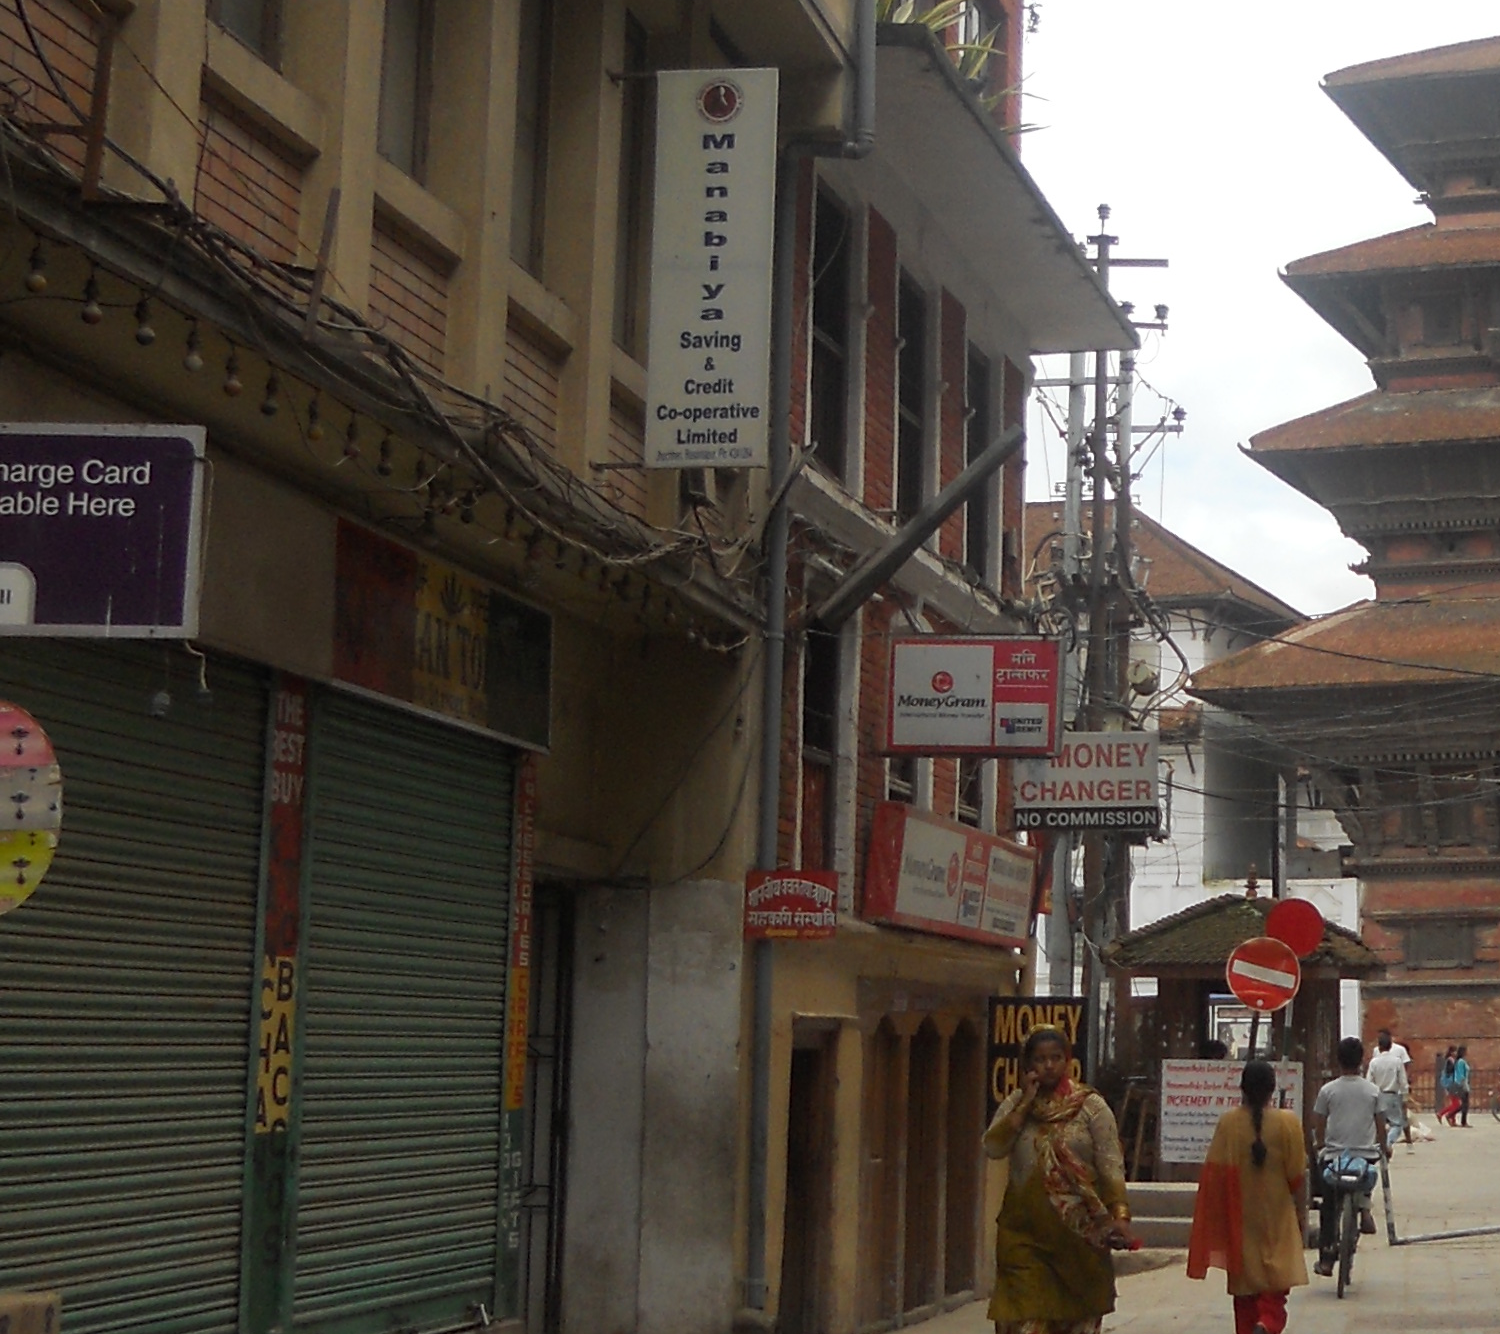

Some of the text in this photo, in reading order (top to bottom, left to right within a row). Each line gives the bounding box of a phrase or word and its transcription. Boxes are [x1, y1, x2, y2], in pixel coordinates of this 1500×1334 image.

[699, 132, 736, 321] Manabiya
[679, 330, 742, 353] Saving
[703, 357, 716, 372] &
[683, 378, 734, 396] Credit
[656, 403, 760, 422] Co-operative
[676, 427, 738, 445] Limited
[82, 459, 151, 485] Card
[67, 491, 136, 517] Here
[897, 694, 987, 709] MoneyGram
[1051, 743, 1149, 768] MONEY
[270, 771, 305, 805] BUY
[1019, 780, 1152, 802] CHANGER
[1016, 810, 1157, 826] NO COMMISSION
[994, 1004, 1082, 1045] MONEY
[1166, 1095, 1212, 1108] INCREMENT
[1215, 1095, 1224, 1108] IN
